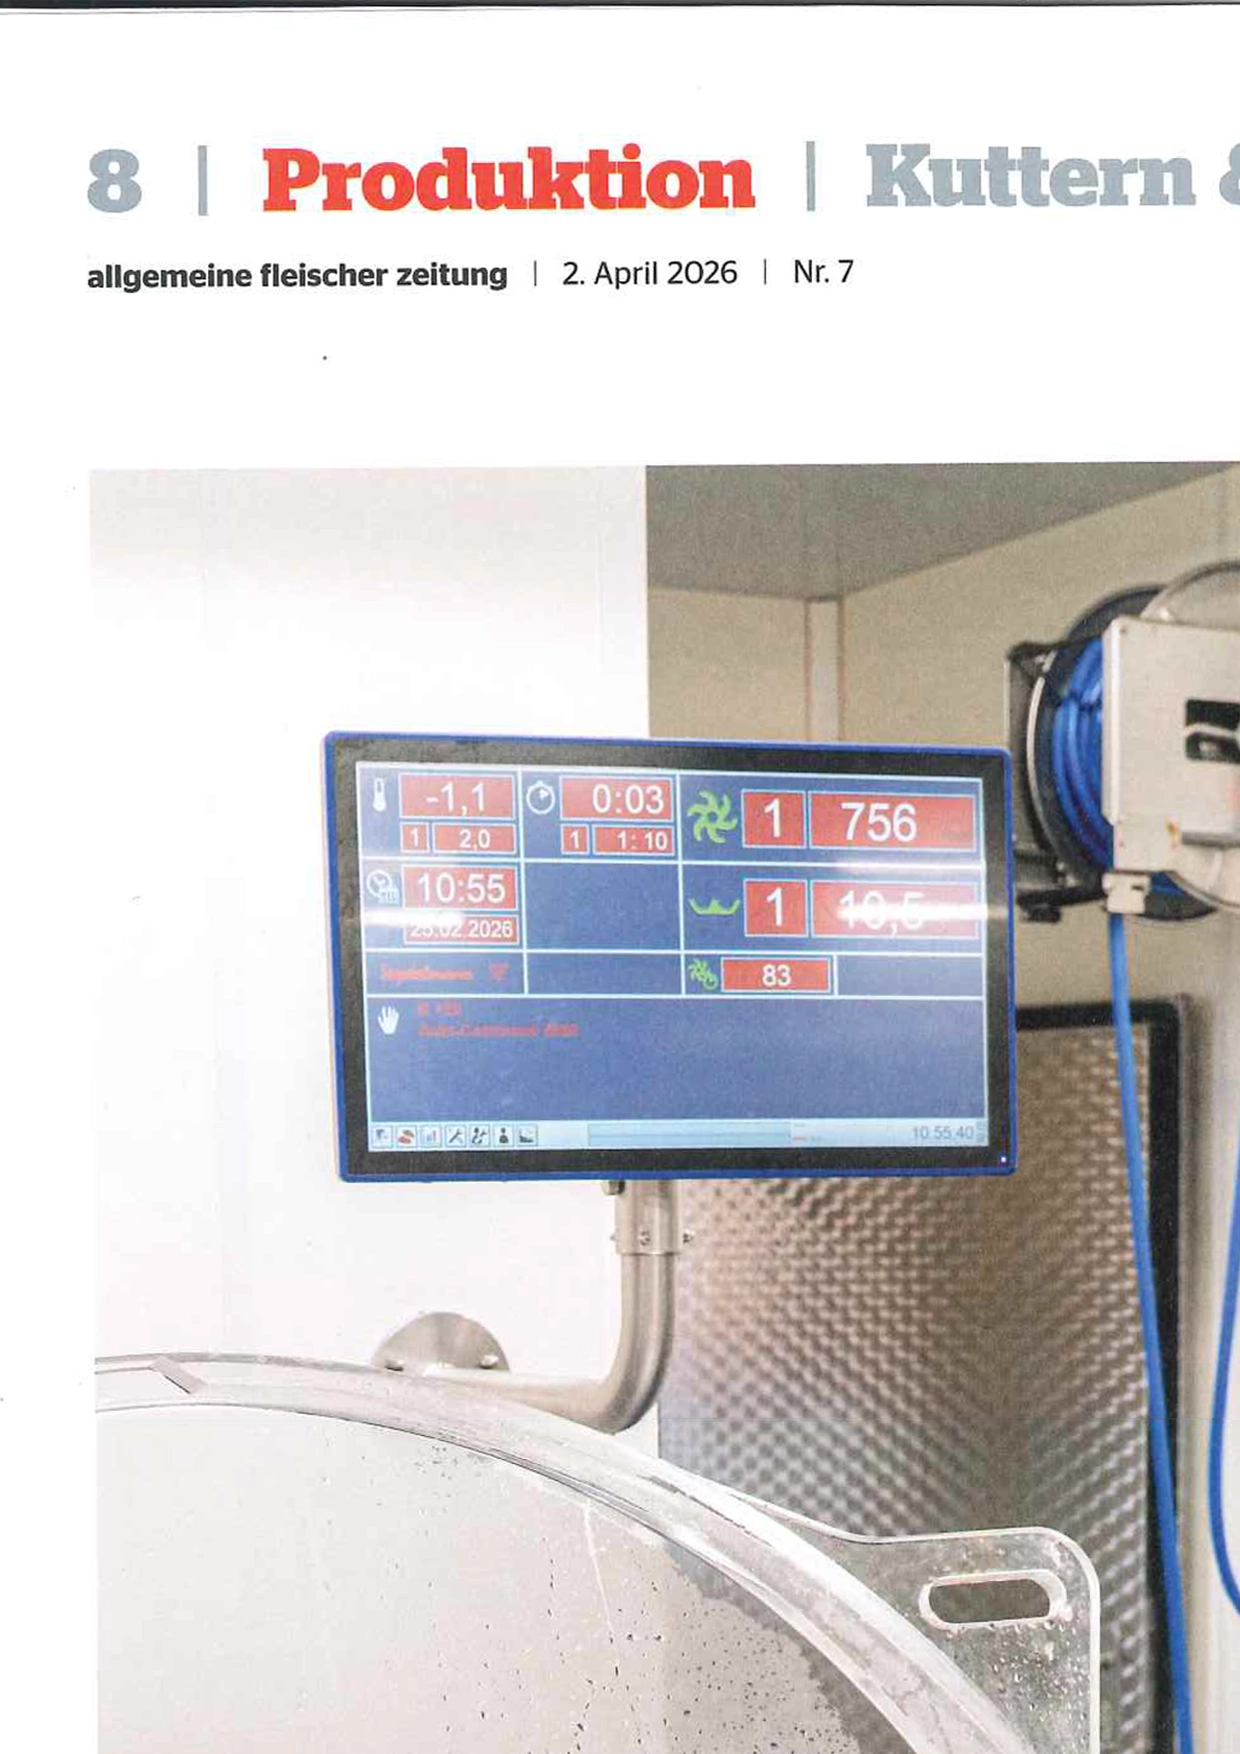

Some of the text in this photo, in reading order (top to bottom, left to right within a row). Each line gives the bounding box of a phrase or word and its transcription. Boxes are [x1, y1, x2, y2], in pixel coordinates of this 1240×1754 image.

[88, 149, 141, 213] 8
[262, 143, 756, 212] Produktion
[866, 143, 1196, 208] Kuttern
[87, 259, 854, 294] allgemeine fleischer zeitung 2. April 2026 Nr. 7
[426, 781, 485, 816] -1,1
[592, 783, 665, 815] 0:03
[763, 798, 781, 838] 1
[840, 801, 918, 842] 756
[410, 828, 420, 847] 1
[570, 830, 580, 849] 1
[418, 873, 506, 904] 10:55
[766, 887, 783, 927] 1
[761, 964, 792, 987] 83
